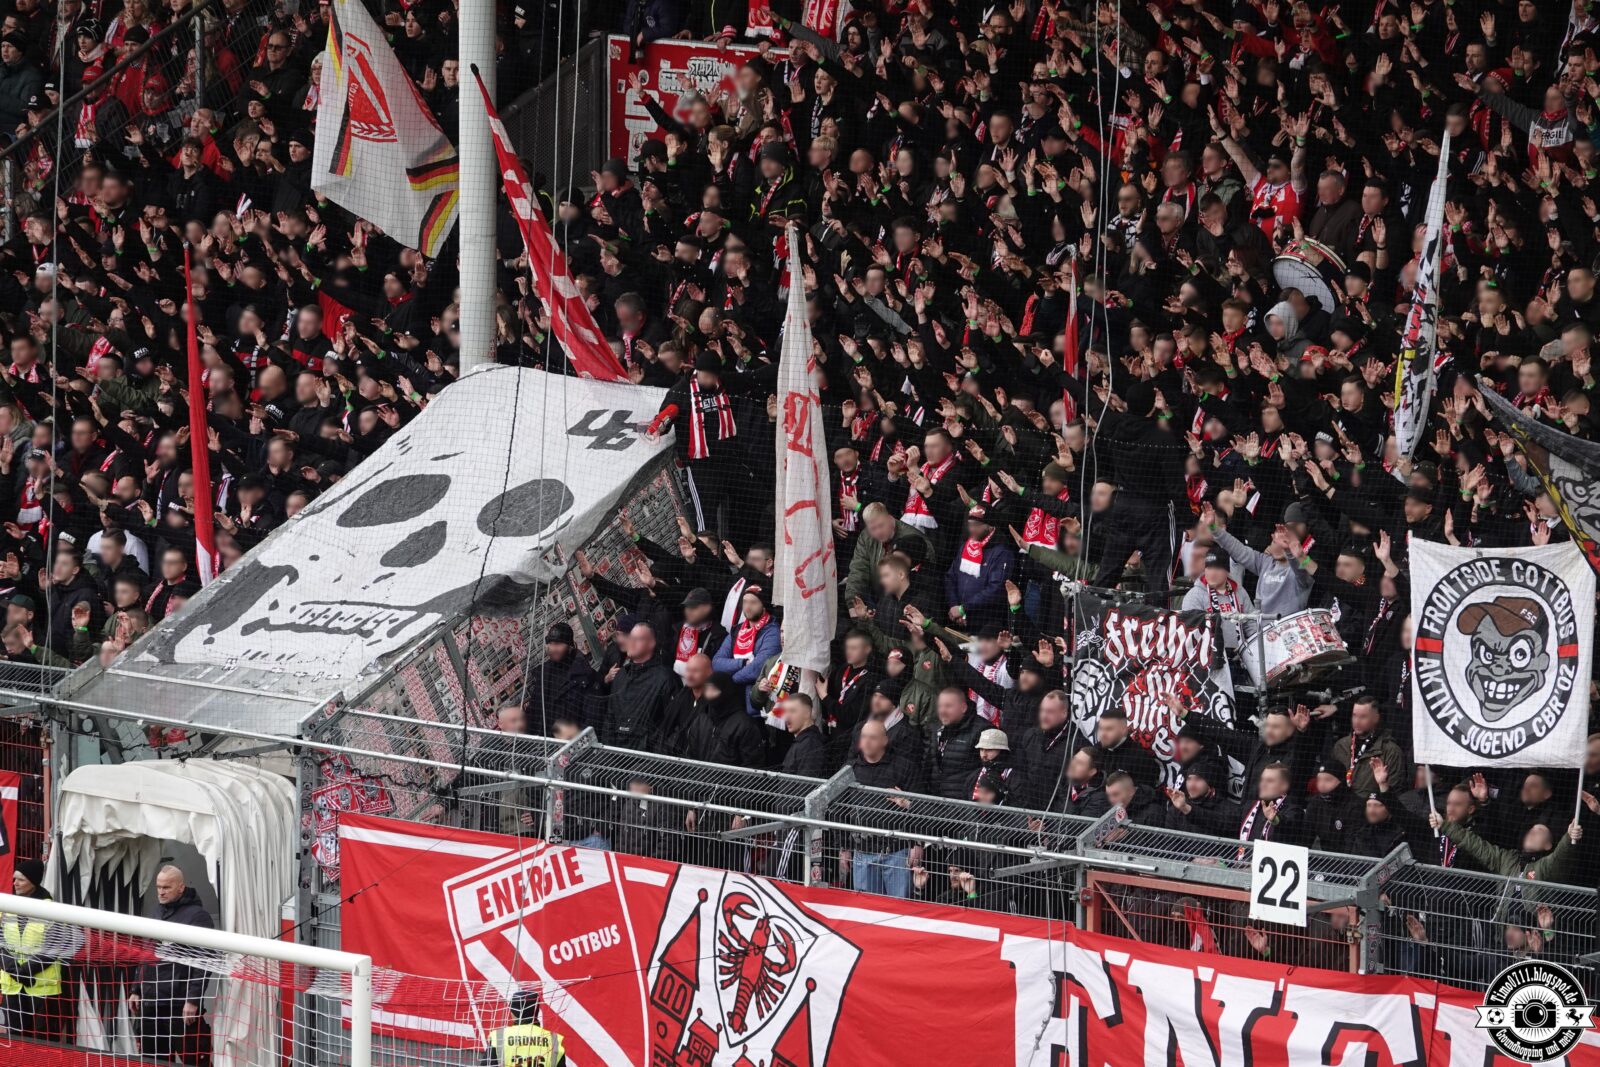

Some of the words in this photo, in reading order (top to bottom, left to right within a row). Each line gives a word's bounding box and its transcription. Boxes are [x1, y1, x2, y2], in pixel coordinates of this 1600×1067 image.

[1423, 560, 1506, 635] FRONTSIDE
[1512, 561, 1574, 639] COTTBUS
[1520, 608, 1537, 624] FSC
[1418, 656, 1464, 735] AKTIVE
[1461, 726, 1527, 755] JUGEND
[476, 847, 584, 924] ENERGIE
[1257, 856, 1300, 910] 22
[549, 924, 621, 965] COTTBUS
[508, 1036, 549, 1047] ORDNER
